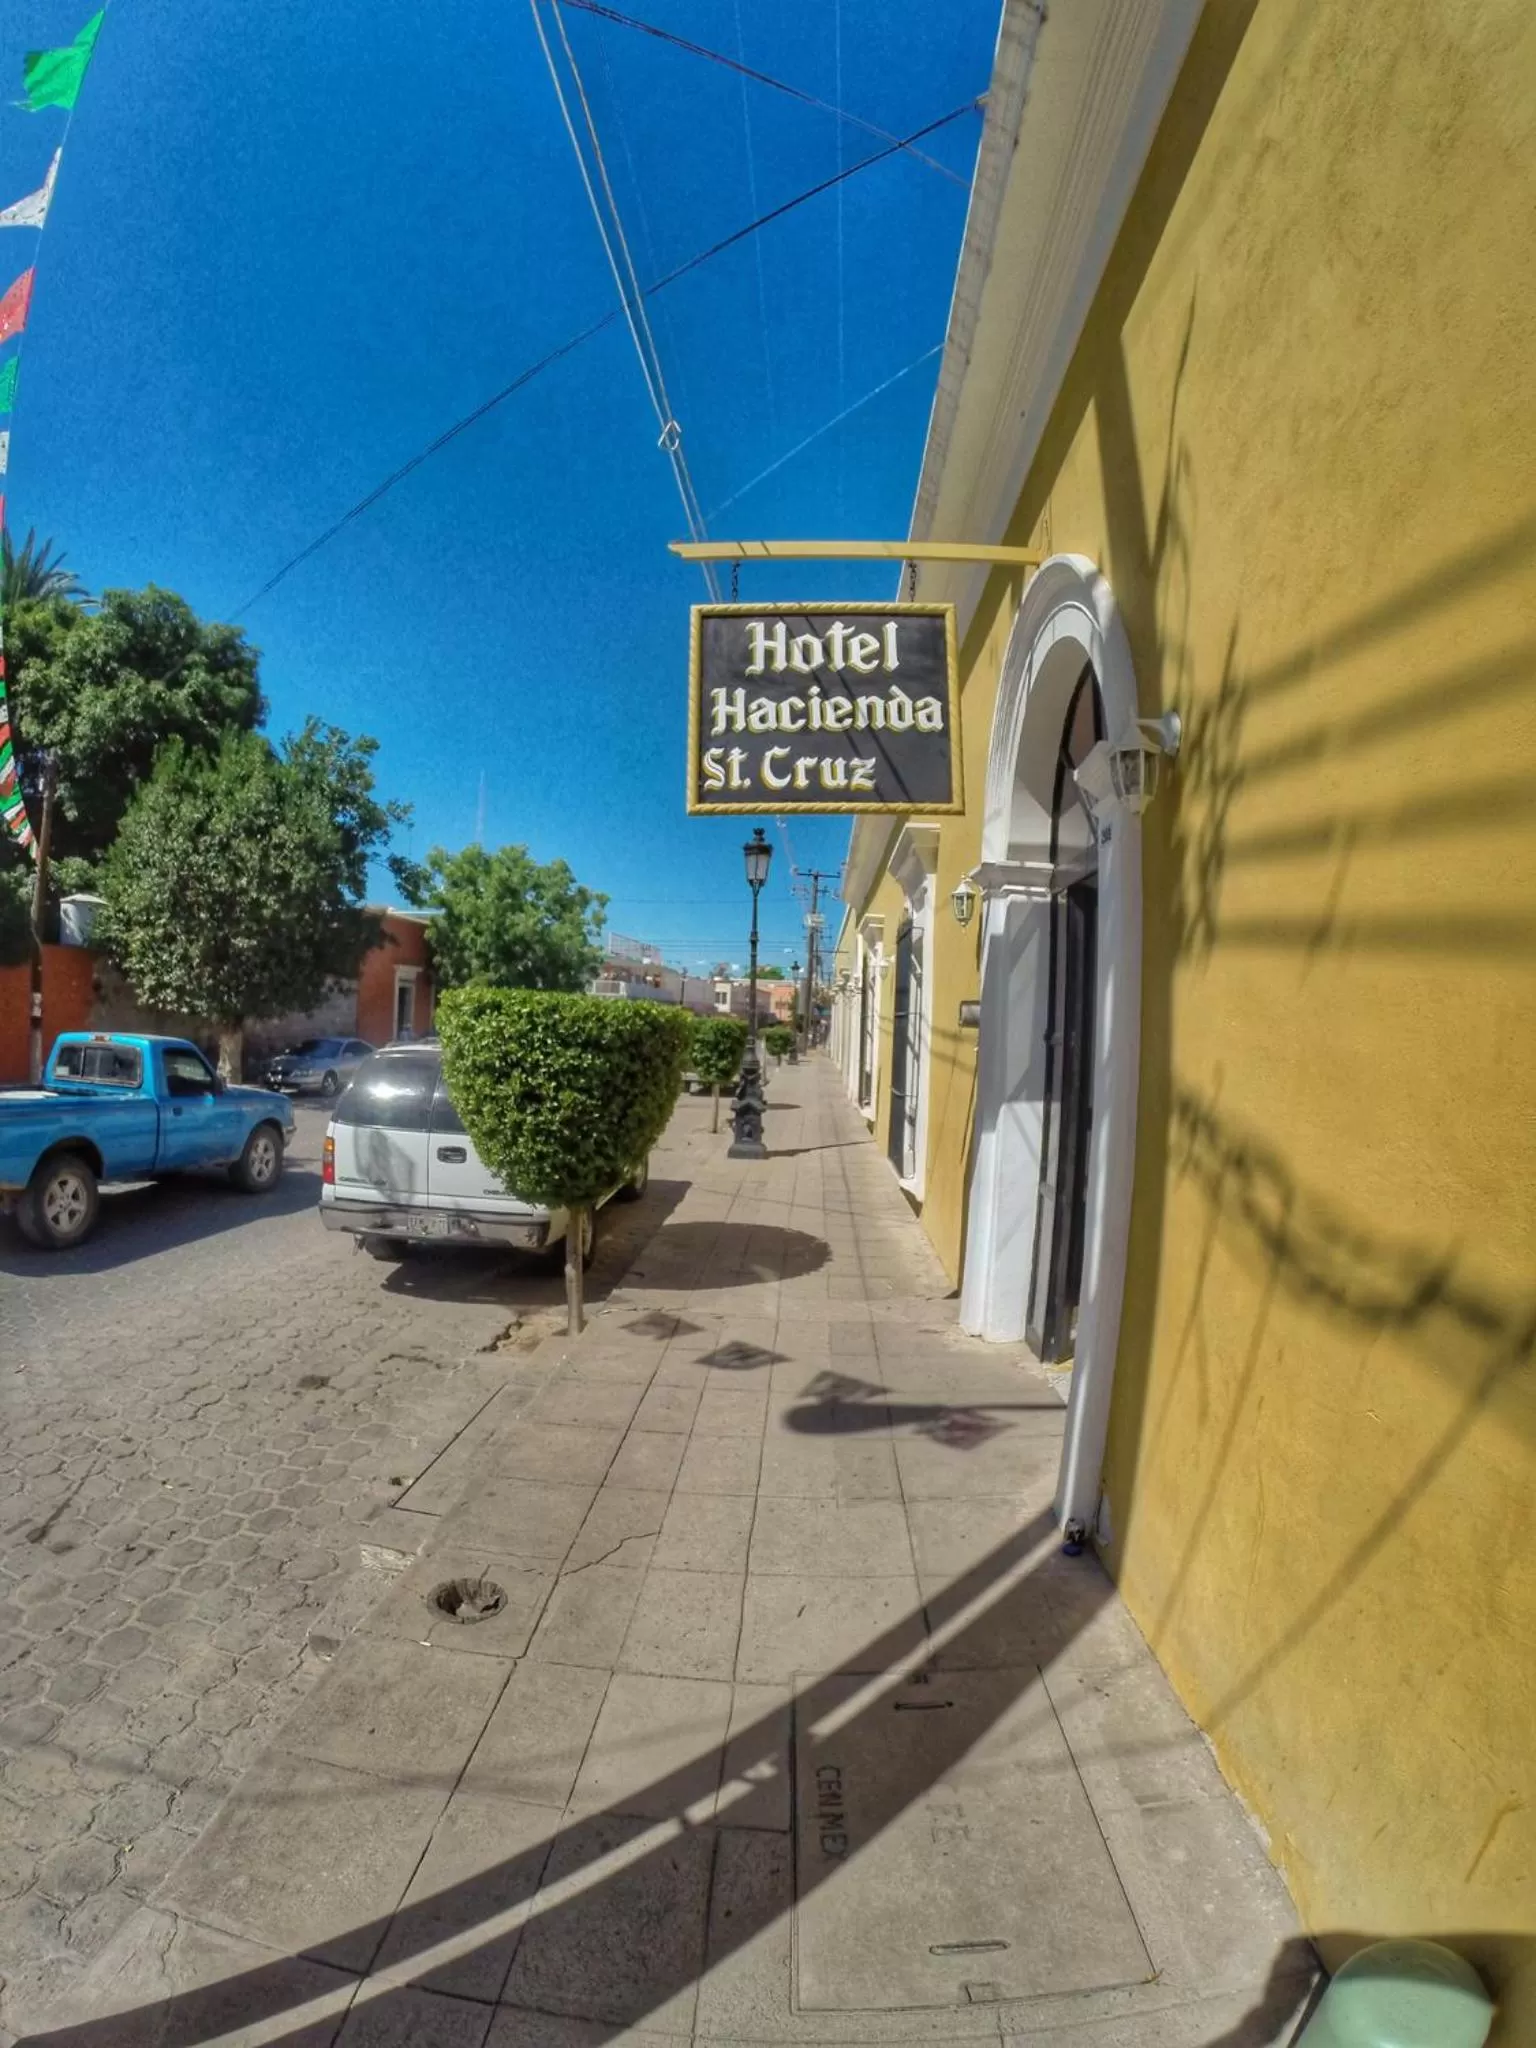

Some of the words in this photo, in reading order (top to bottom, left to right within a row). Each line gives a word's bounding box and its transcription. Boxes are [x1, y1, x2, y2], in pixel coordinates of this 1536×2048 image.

[744, 620, 900, 677] Hotel
[710, 685, 945, 737] Hacienda
[702, 746, 751, 792] St.
[759, 745, 877, 793] Cruz
